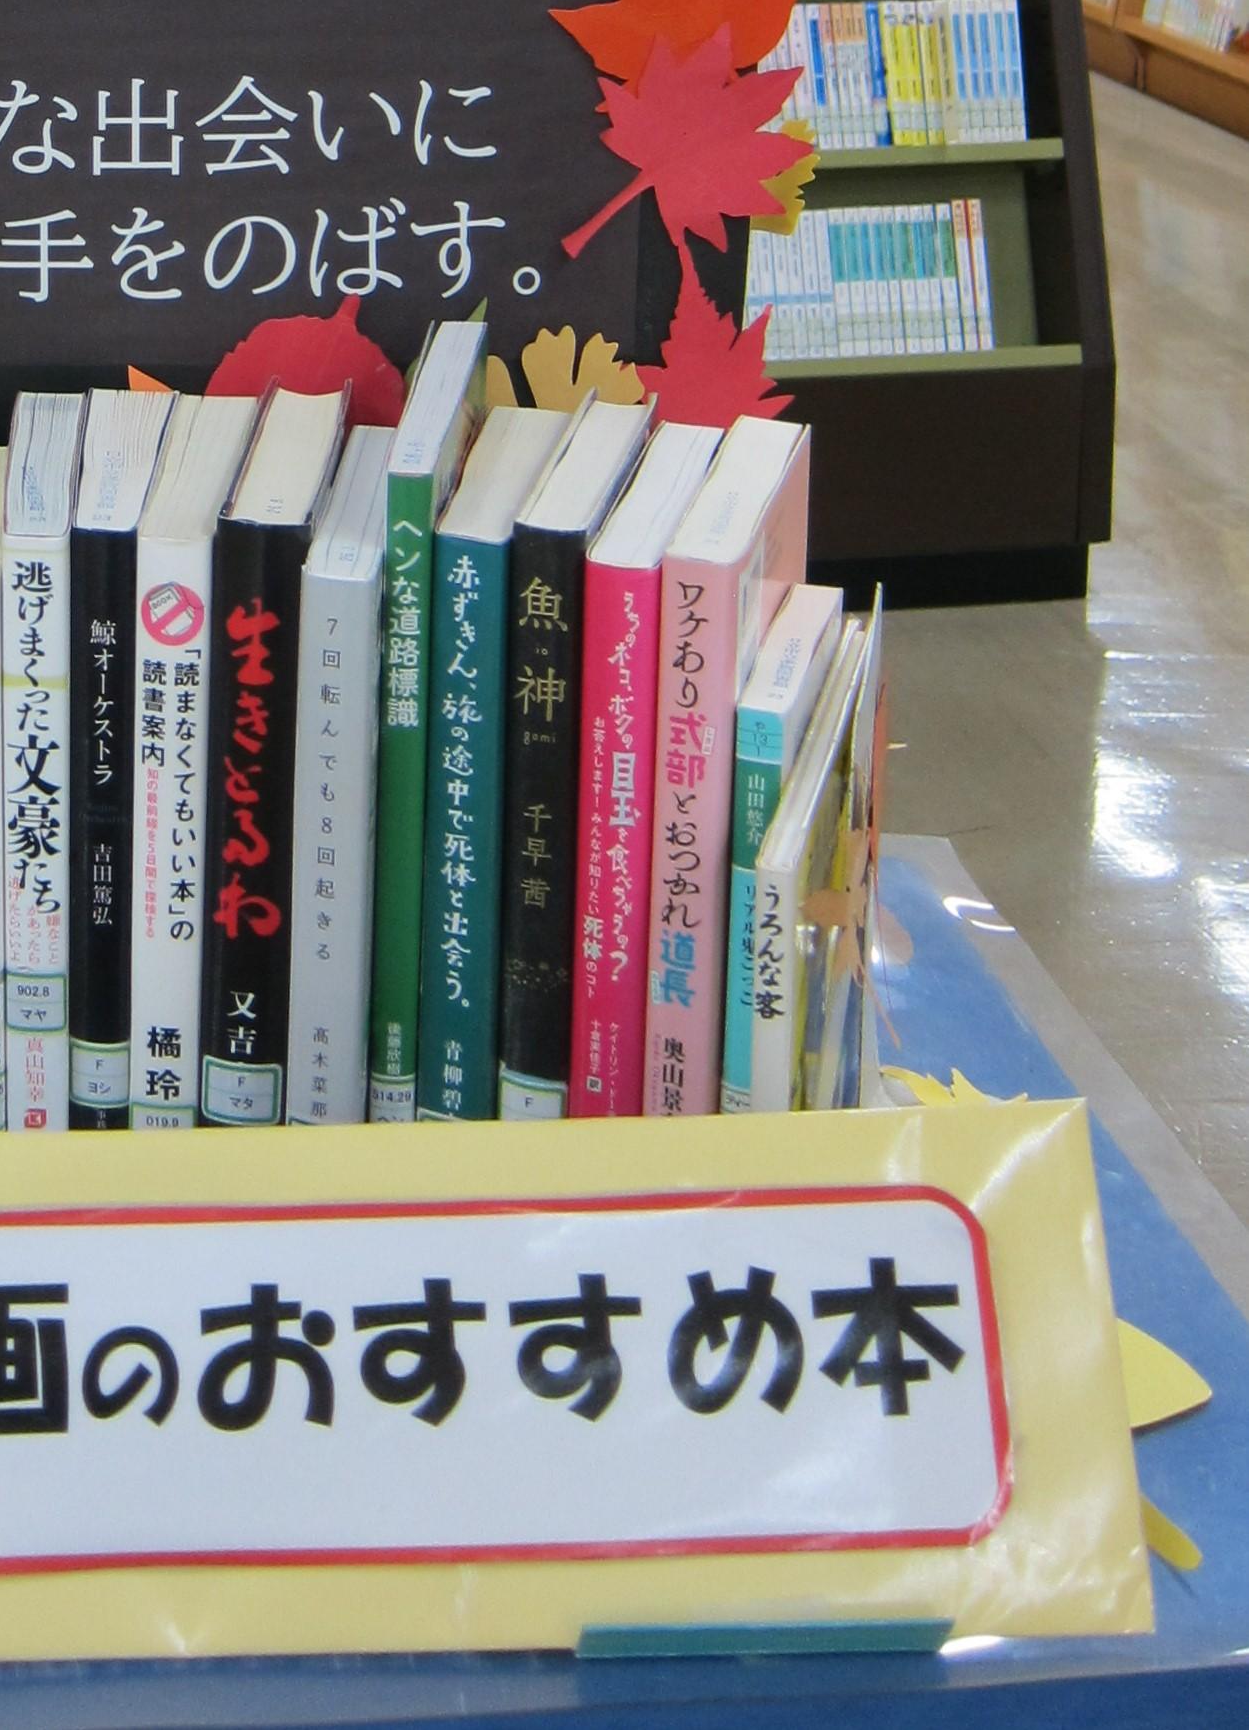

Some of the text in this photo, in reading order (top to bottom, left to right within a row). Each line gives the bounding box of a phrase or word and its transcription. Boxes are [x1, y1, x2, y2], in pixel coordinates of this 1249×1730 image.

[387, 520, 423, 727] ヘンな道路標識
[6, 561, 62, 913] 逃げまくった文豪たち
[90, 619, 117, 786] 鯨オーケストラ
[141, 659, 167, 768] 読書案内
[523, 731, 556, 745] gami
[169, 649, 202, 940] 「読まなくてもいい本」の
[213, 596, 282, 939] 生きとるわ
[314, 619, 342, 960] 7回転んでも8回起きる
[440, 555, 482, 1008] 赤ずきん、旅の途中で死体と出会う。
[661, 581, 708, 1010] ワケあり式部とおつかれ道長
[93, 844, 113, 925] 吉田篤弘
[520, 804, 552, 908] 千早茜
[17, 985, 50, 997] 902.8
[755, 884, 785, 1019] うろんな客
[20, 1009, 47, 1020] マヤ
[226, 990, 257, 1055] 又吉
[87, 1082, 111, 1094] ヨシ
[95, 1059, 104, 1070] F
[146, 1026, 182, 1100] 橘玲
[229, 1097, 254, 1108] マタ
[237, 1077, 246, 1087] F
[442, 1039, 463, 1117] 青柳碧
[525, 1097, 533, 1108] F
[661, 1037, 686, 1116] 奥山景
